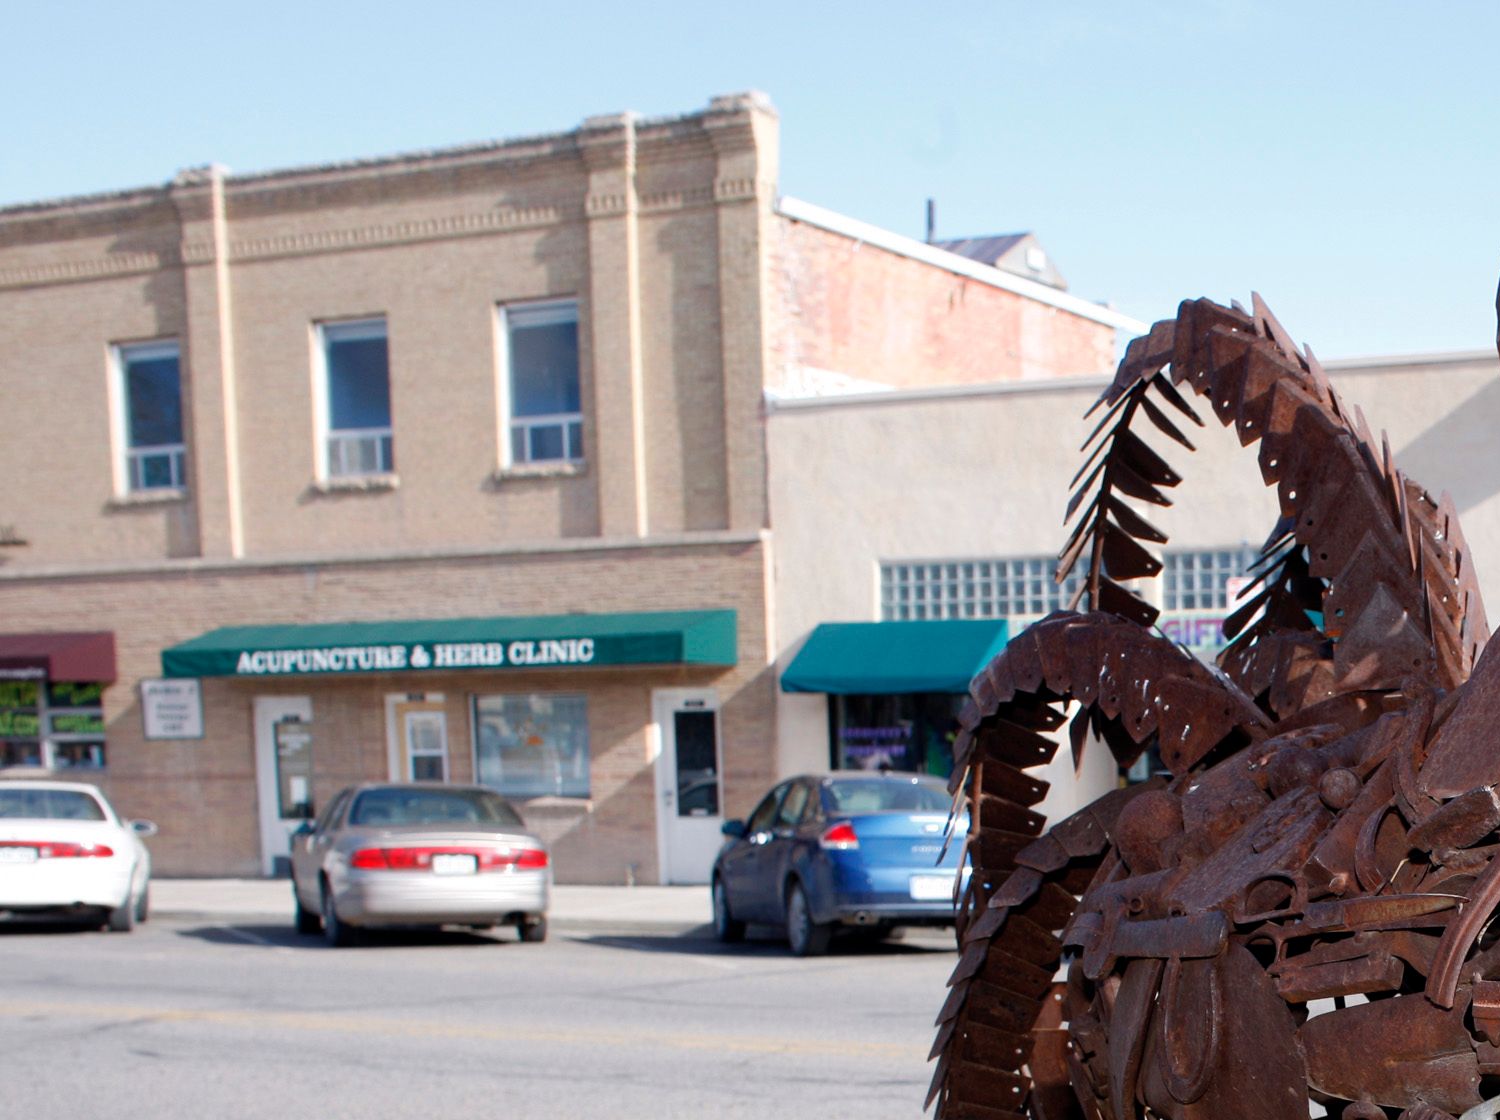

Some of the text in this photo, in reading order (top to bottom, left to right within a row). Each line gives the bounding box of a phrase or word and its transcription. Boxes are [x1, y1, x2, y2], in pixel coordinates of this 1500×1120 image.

[236, 638, 595, 674] ACUPUNCTURE & HERB CLINIC
